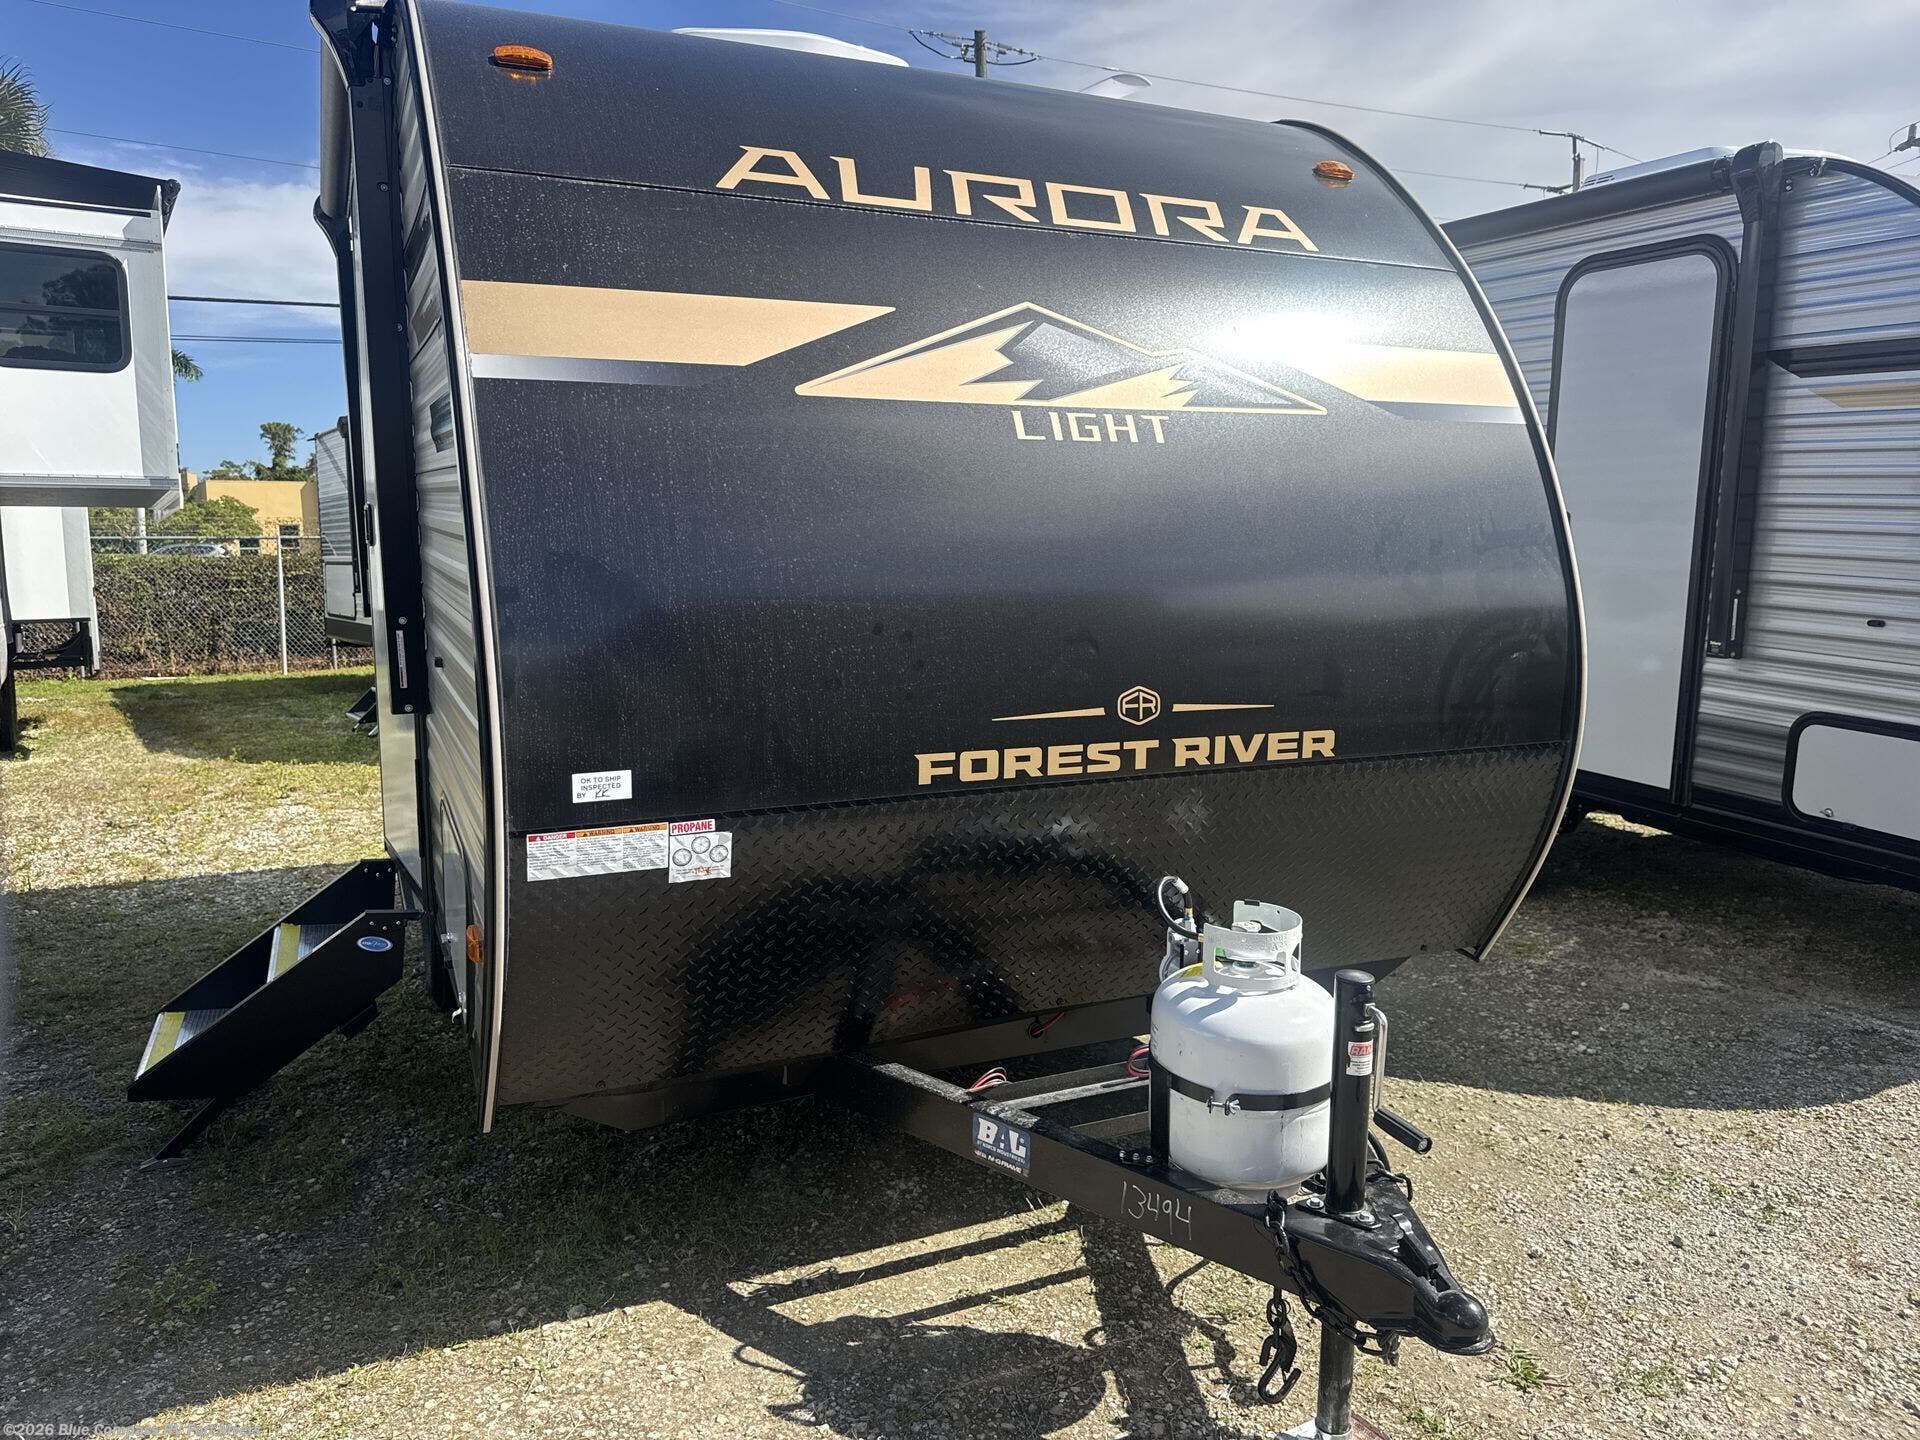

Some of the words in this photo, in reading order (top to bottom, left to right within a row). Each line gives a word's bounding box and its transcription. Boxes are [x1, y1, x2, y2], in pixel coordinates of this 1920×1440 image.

[716, 145, 1319, 252] AURORA
[1013, 411, 1170, 444] LIGHT
[914, 740, 1159, 786] FOREST
[1171, 730, 1336, 768] RIVER
[580, 783, 621, 791] INSPECTED
[671, 821, 713, 833] PROPANE
[1120, 1180, 1192, 1241] 13494
